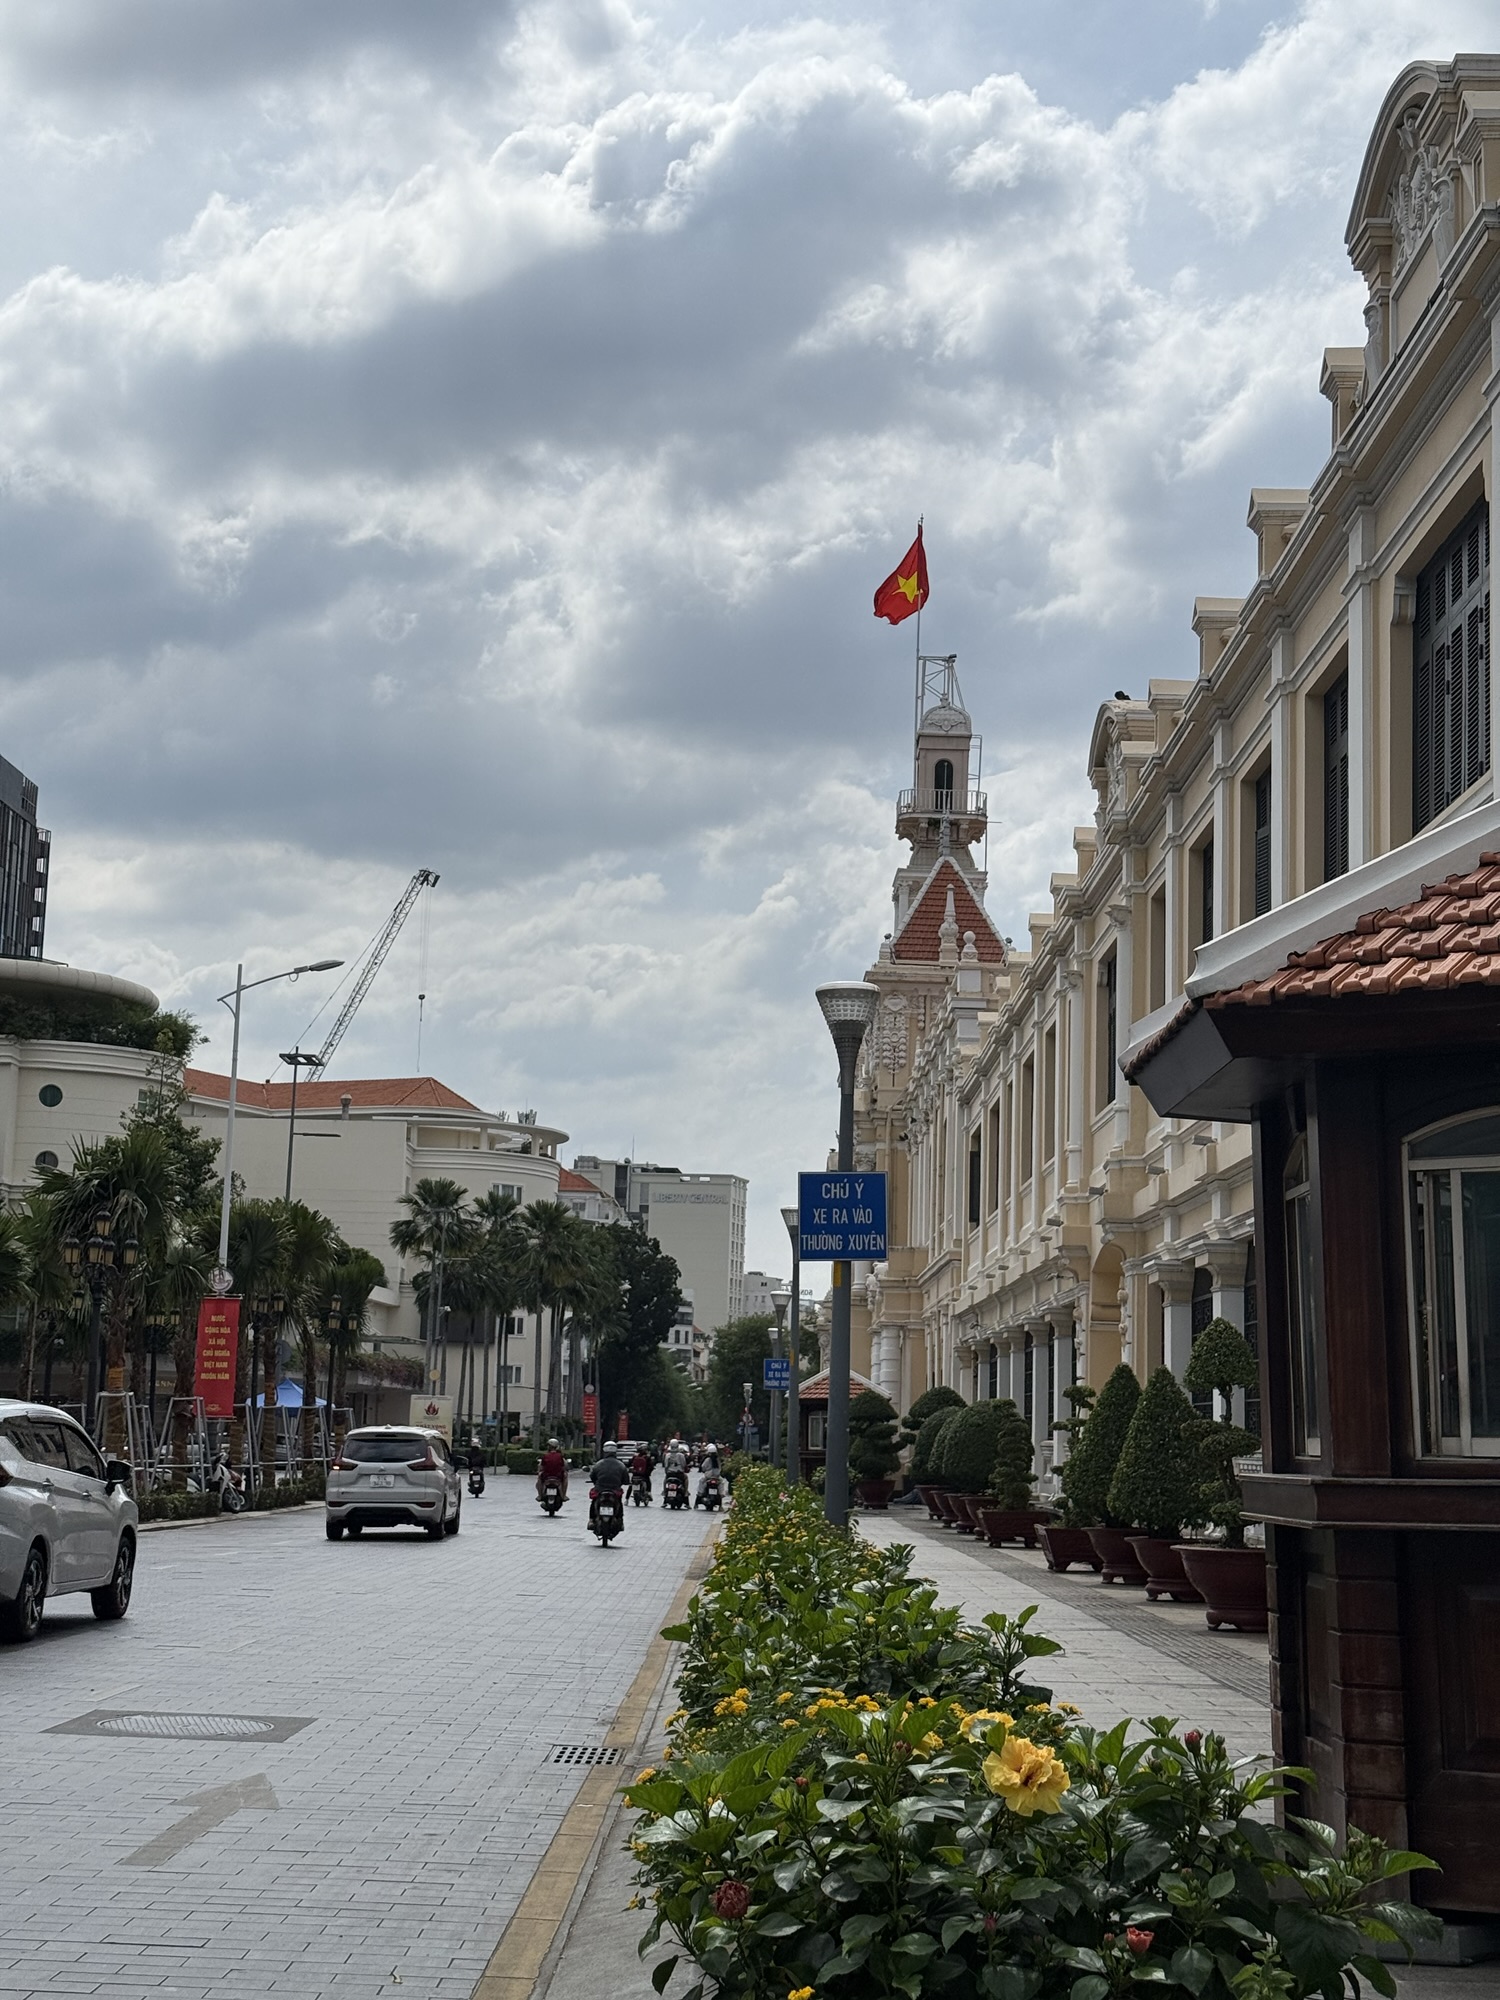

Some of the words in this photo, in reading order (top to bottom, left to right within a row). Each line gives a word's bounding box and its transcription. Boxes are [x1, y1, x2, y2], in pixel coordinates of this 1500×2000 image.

[690, 1193, 728, 1204] CENTRAL
[822, 1178, 850, 1199] CHÚ
[855, 1178, 864, 1199] Ý
[813, 1208, 828, 1224] XE
[832, 1208, 848, 1224] RA
[852, 1204, 873, 1224] VÀO
[801, 1230, 843, 1251] THƯỜNG
[848, 1230, 885, 1251] XUYÊN
